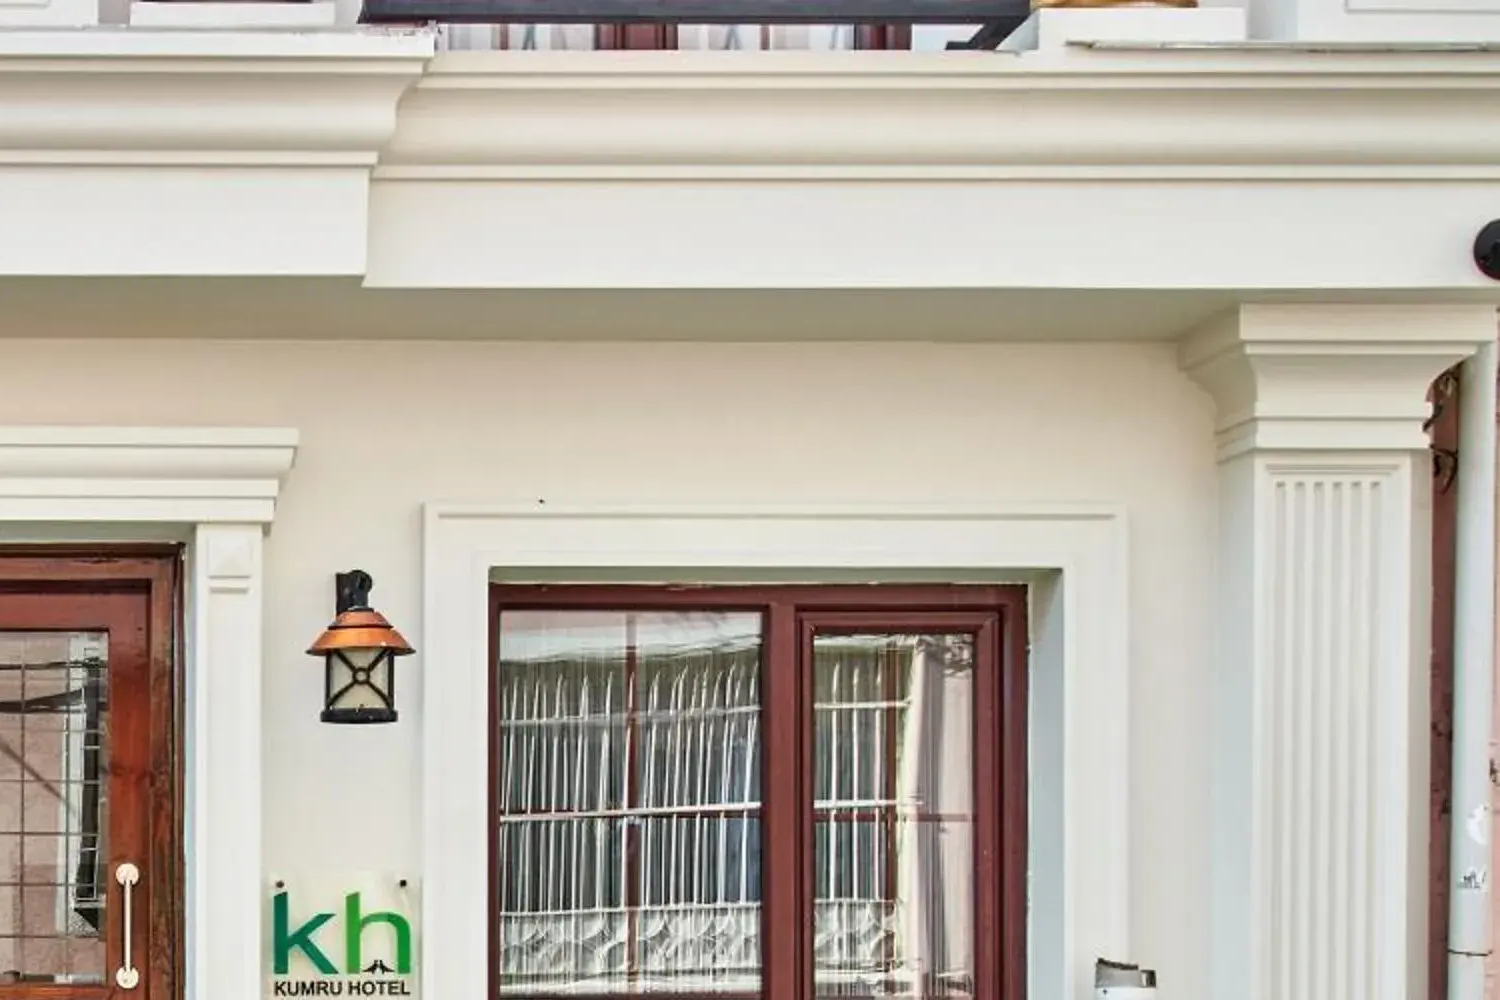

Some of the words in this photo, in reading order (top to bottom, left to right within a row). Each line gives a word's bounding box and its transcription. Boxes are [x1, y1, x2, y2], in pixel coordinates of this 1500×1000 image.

[273, 891, 411, 975] kh
[274, 981, 343, 996] KUMRU
[348, 981, 411, 996] HOTEL
